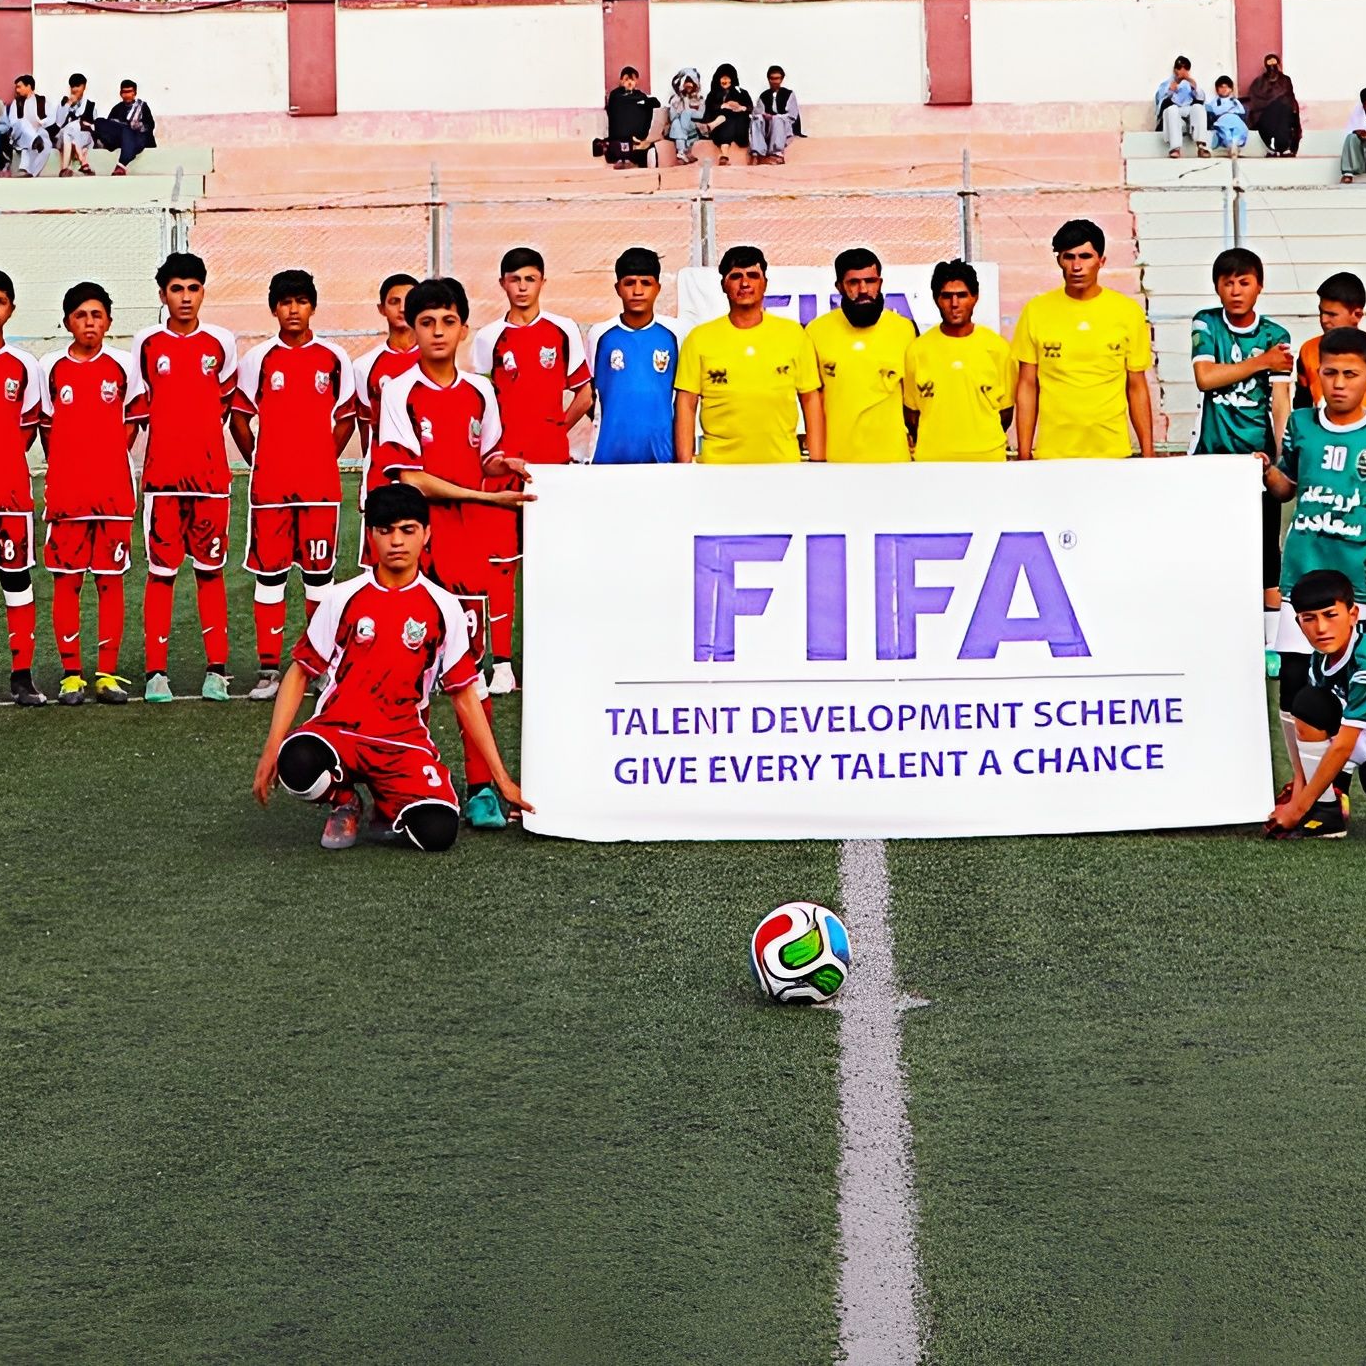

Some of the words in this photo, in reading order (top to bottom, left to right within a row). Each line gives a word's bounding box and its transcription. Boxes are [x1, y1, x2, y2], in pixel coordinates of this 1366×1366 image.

[1321, 445, 1348, 472] 30
[113, 542, 124, 562] 6
[210, 537, 221, 559] 2
[309, 539, 327, 561] 10
[693, 531, 1092, 662] FIFA
[605, 706, 741, 735] TALENT
[752, 702, 1024, 733] DEVELOPMENT
[1034, 697, 1183, 728] SCHEME
[422, 765, 443, 787] 3
[614, 756, 698, 785] GIVE
[709, 754, 822, 783] EVERY
[830, 750, 968, 780] TALENT
[978, 749, 1002, 776] A
[1013, 743, 1164, 774] CHANCE
